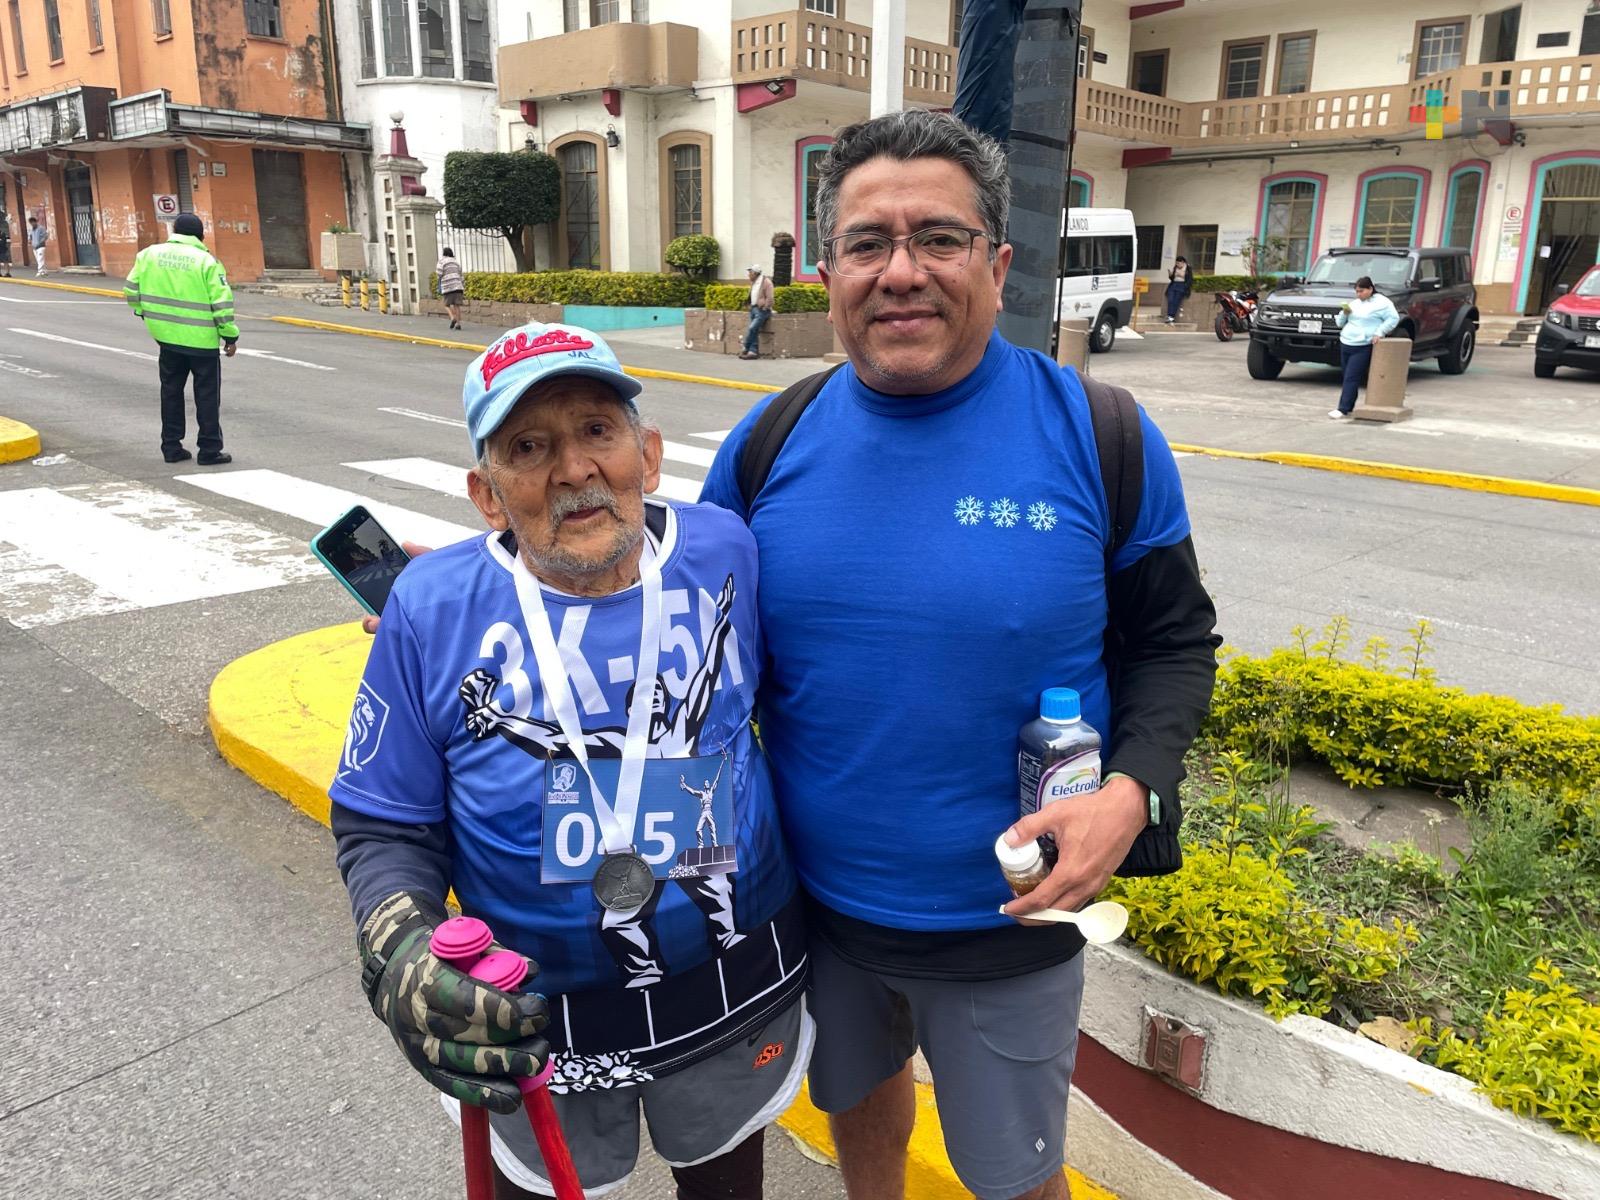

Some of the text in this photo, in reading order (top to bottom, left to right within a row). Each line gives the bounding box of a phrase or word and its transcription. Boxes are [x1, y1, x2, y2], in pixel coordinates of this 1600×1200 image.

[1068, 217, 1089, 231] LANCO
[1051, 776, 1099, 796] Electrolit
[555, 811, 676, 867] 05
